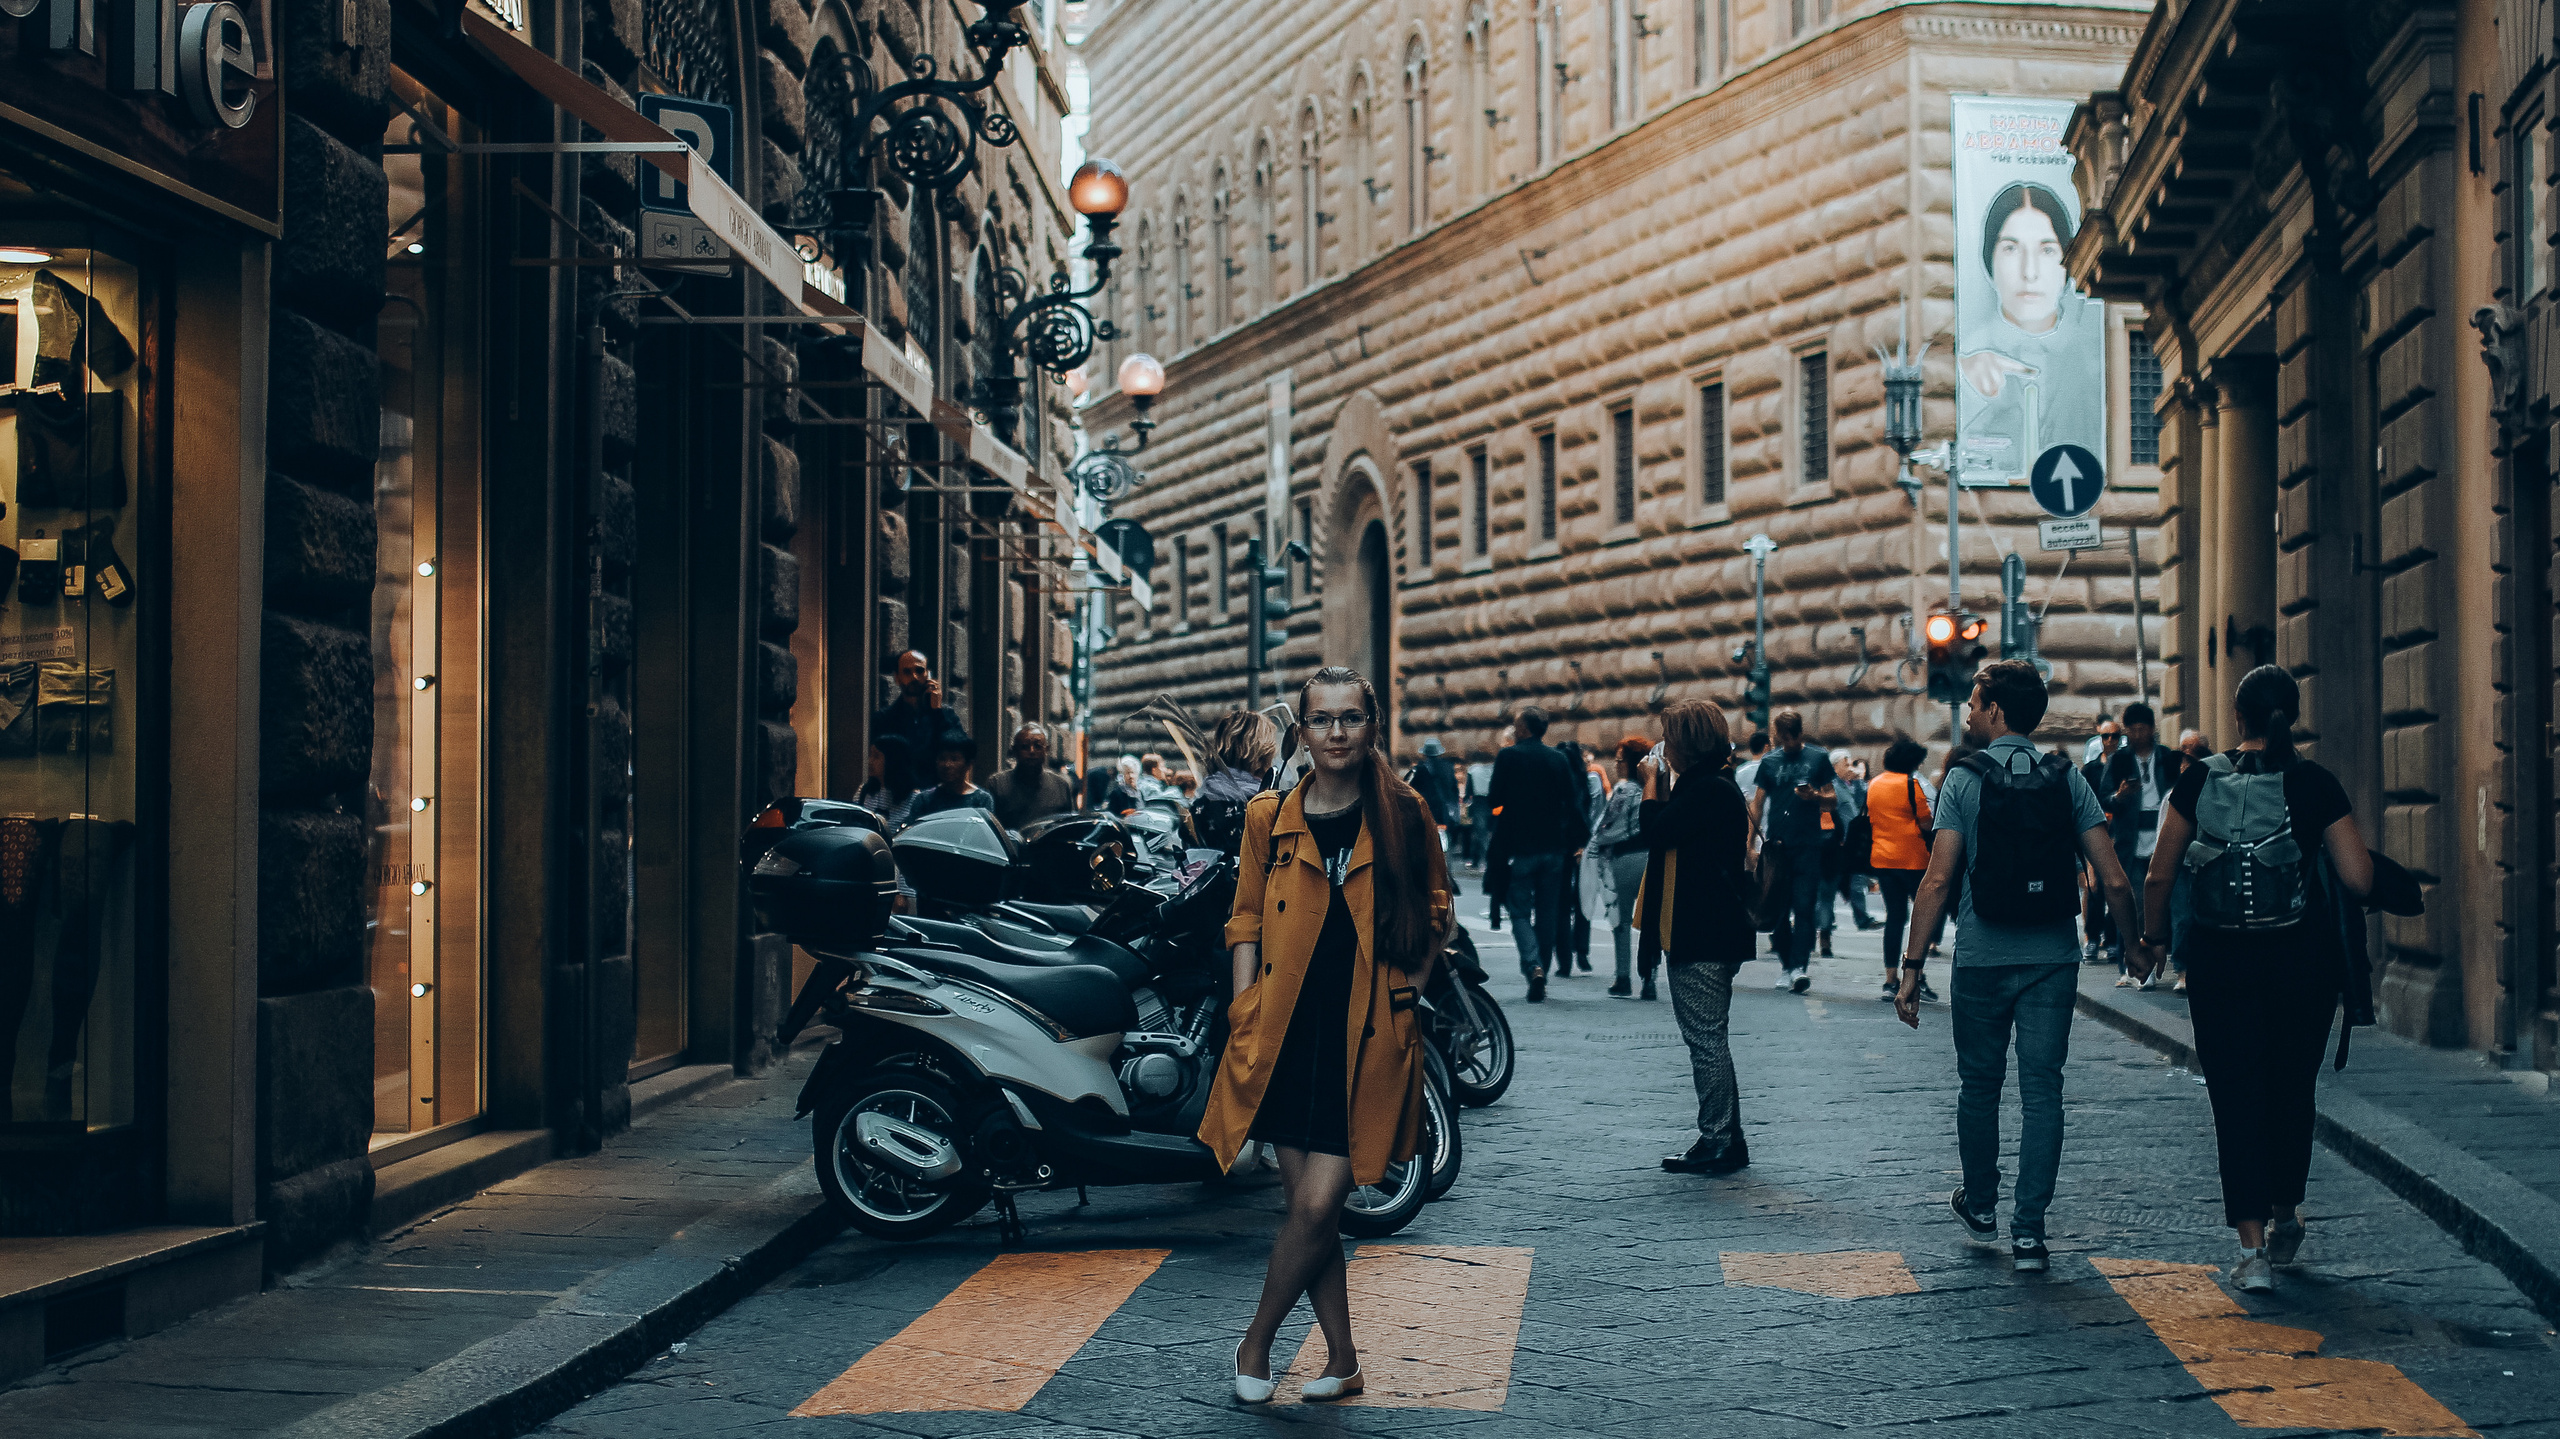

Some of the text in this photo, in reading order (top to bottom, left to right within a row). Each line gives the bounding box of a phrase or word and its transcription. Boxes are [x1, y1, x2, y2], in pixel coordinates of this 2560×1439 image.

[1992, 117, 2060, 132] MARINA
[659, 108, 714, 199] P
[2051, 522, 2090, 533] eccetto
[2046, 535, 2097, 548] autorizzati
[25, 632, 54, 643] sconto
[56, 627, 73, 639] 10%
[2, 645, 74, 660] pezzi sconto 20%
